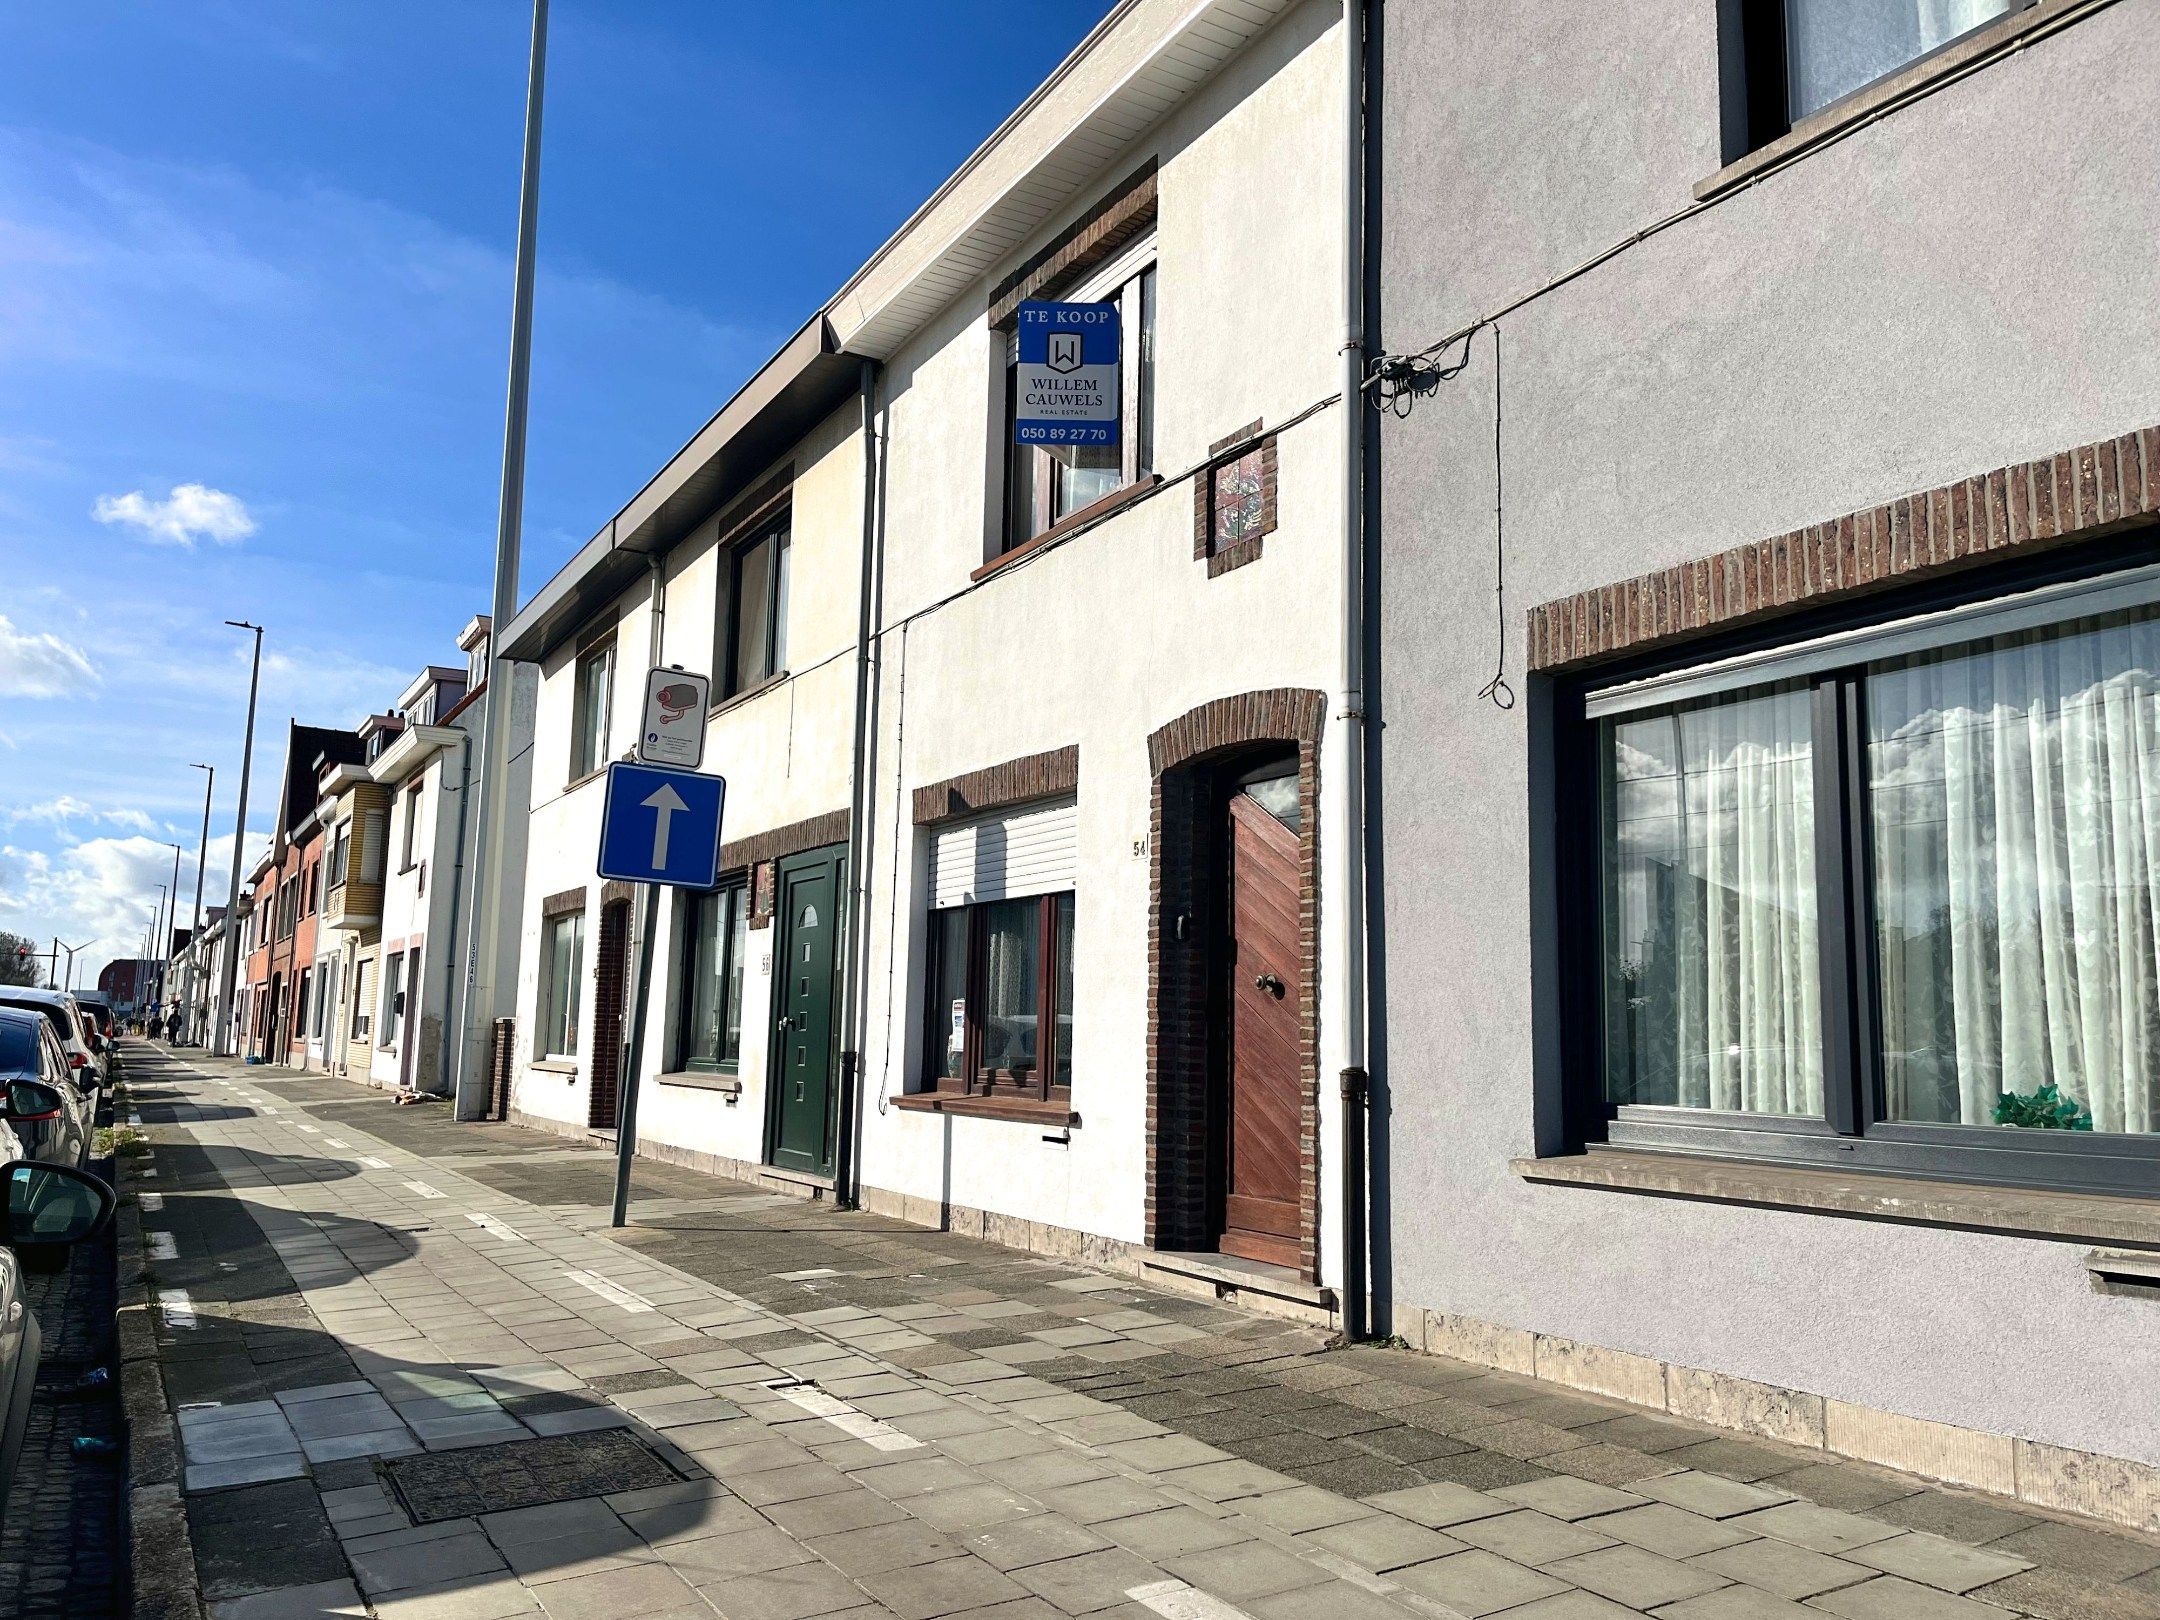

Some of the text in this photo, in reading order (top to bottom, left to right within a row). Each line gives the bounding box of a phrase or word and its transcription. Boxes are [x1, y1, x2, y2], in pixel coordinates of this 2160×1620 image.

[1024, 310, 1109, 324] TE KOOP
[1031, 378, 1098, 391] WILLEM
[1025, 393, 1103, 407] CAUWELS
[1021, 427, 1107, 440] 050 89 27 70
[1133, 841, 1146, 857] 54
